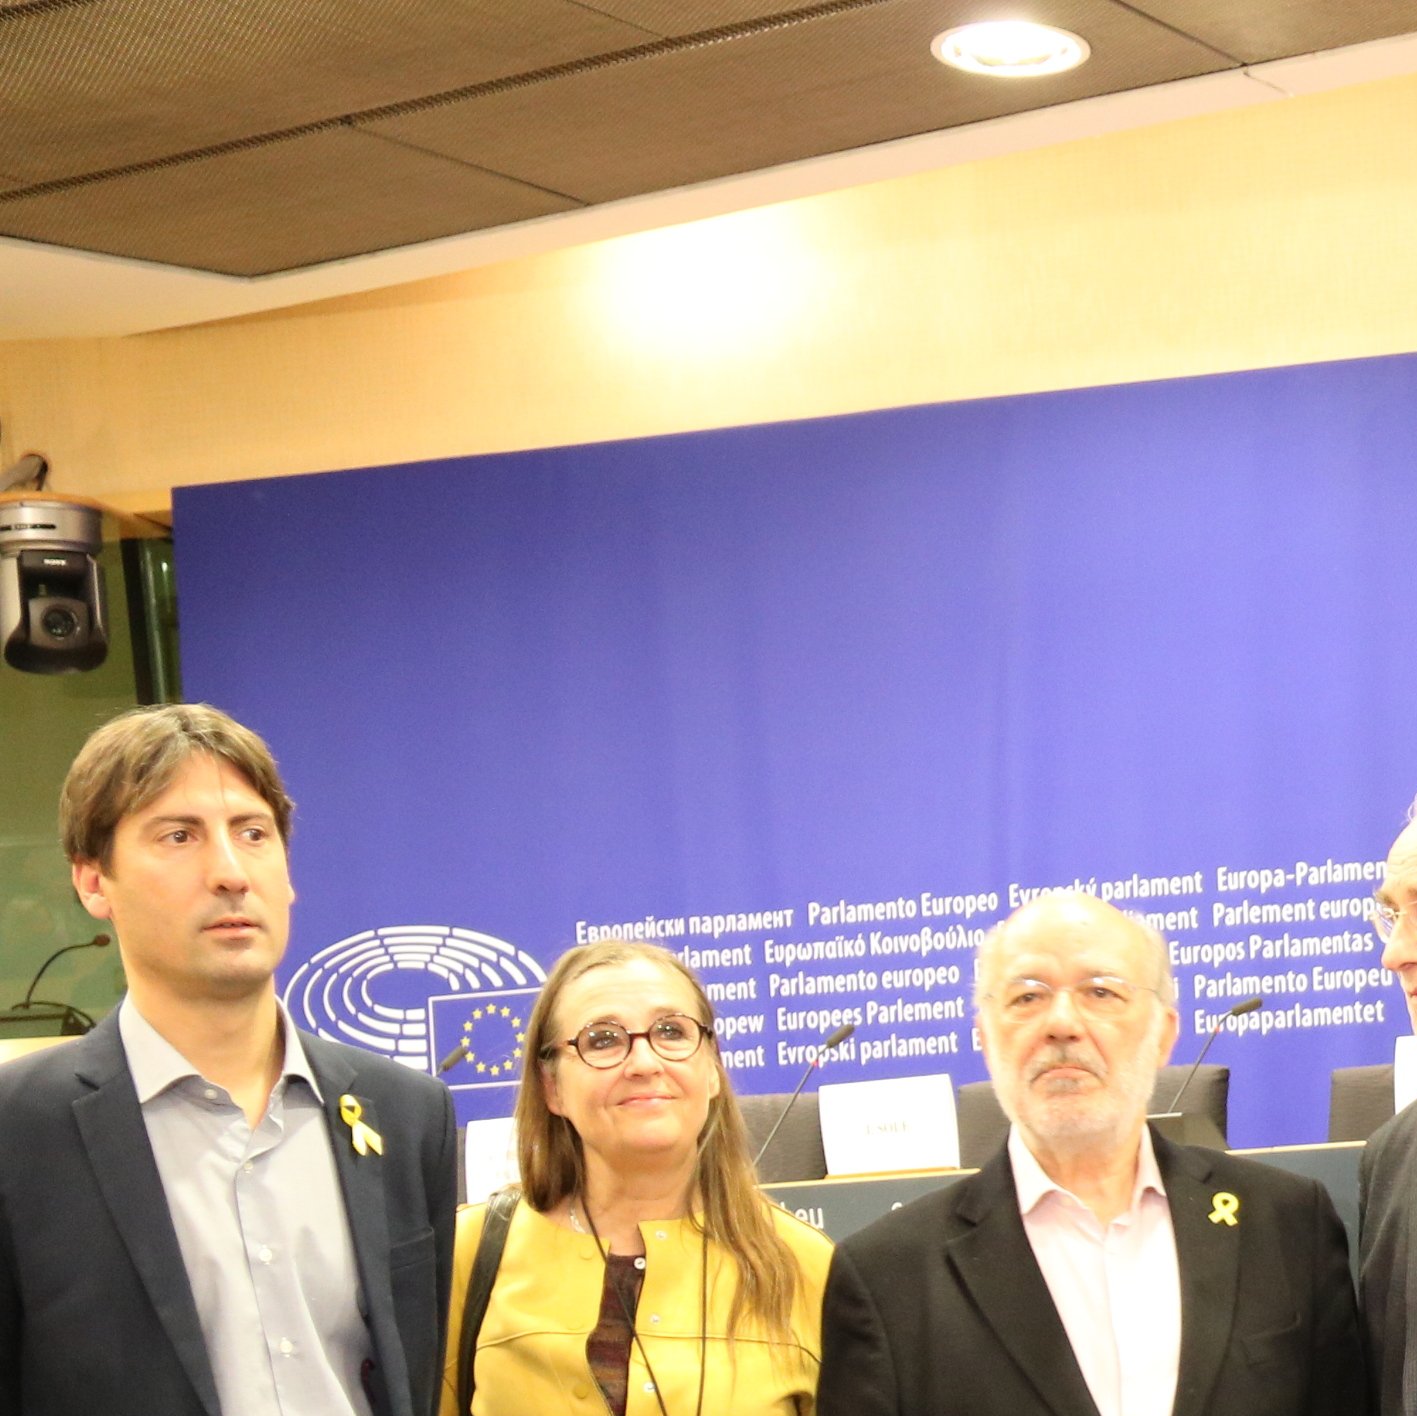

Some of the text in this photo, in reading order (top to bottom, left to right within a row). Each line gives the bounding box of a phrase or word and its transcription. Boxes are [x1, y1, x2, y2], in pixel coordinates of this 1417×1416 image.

[689, 909, 794, 938] парламент
[808, 897, 917, 926] Parlamento
[921, 892, 998, 919] Europeo
[1101, 871, 1203, 900] parlament
[1217, 859, 1387, 893] Europa-Parlamen
[1212, 899, 1315, 928] Parlement
[765, 924, 985, 968] Ευρωπαϊκό Κοινοβούλιο
[769, 963, 878, 998] Parlamento
[881, 965, 960, 991] europeo
[1169, 941, 1245, 968] Europos
[1250, 930, 1374, 960] Parlamentas
[777, 1006, 862, 1034] Europees
[867, 996, 964, 1024] Parlement
[1194, 972, 1308, 999] Parlamento
[1313, 966, 1393, 993] Europeu
[778, 1035, 856, 1068] Evropski
[861, 1031, 958, 1065] parlament
[1195, 1000, 1385, 1037] Europaparlamentet
